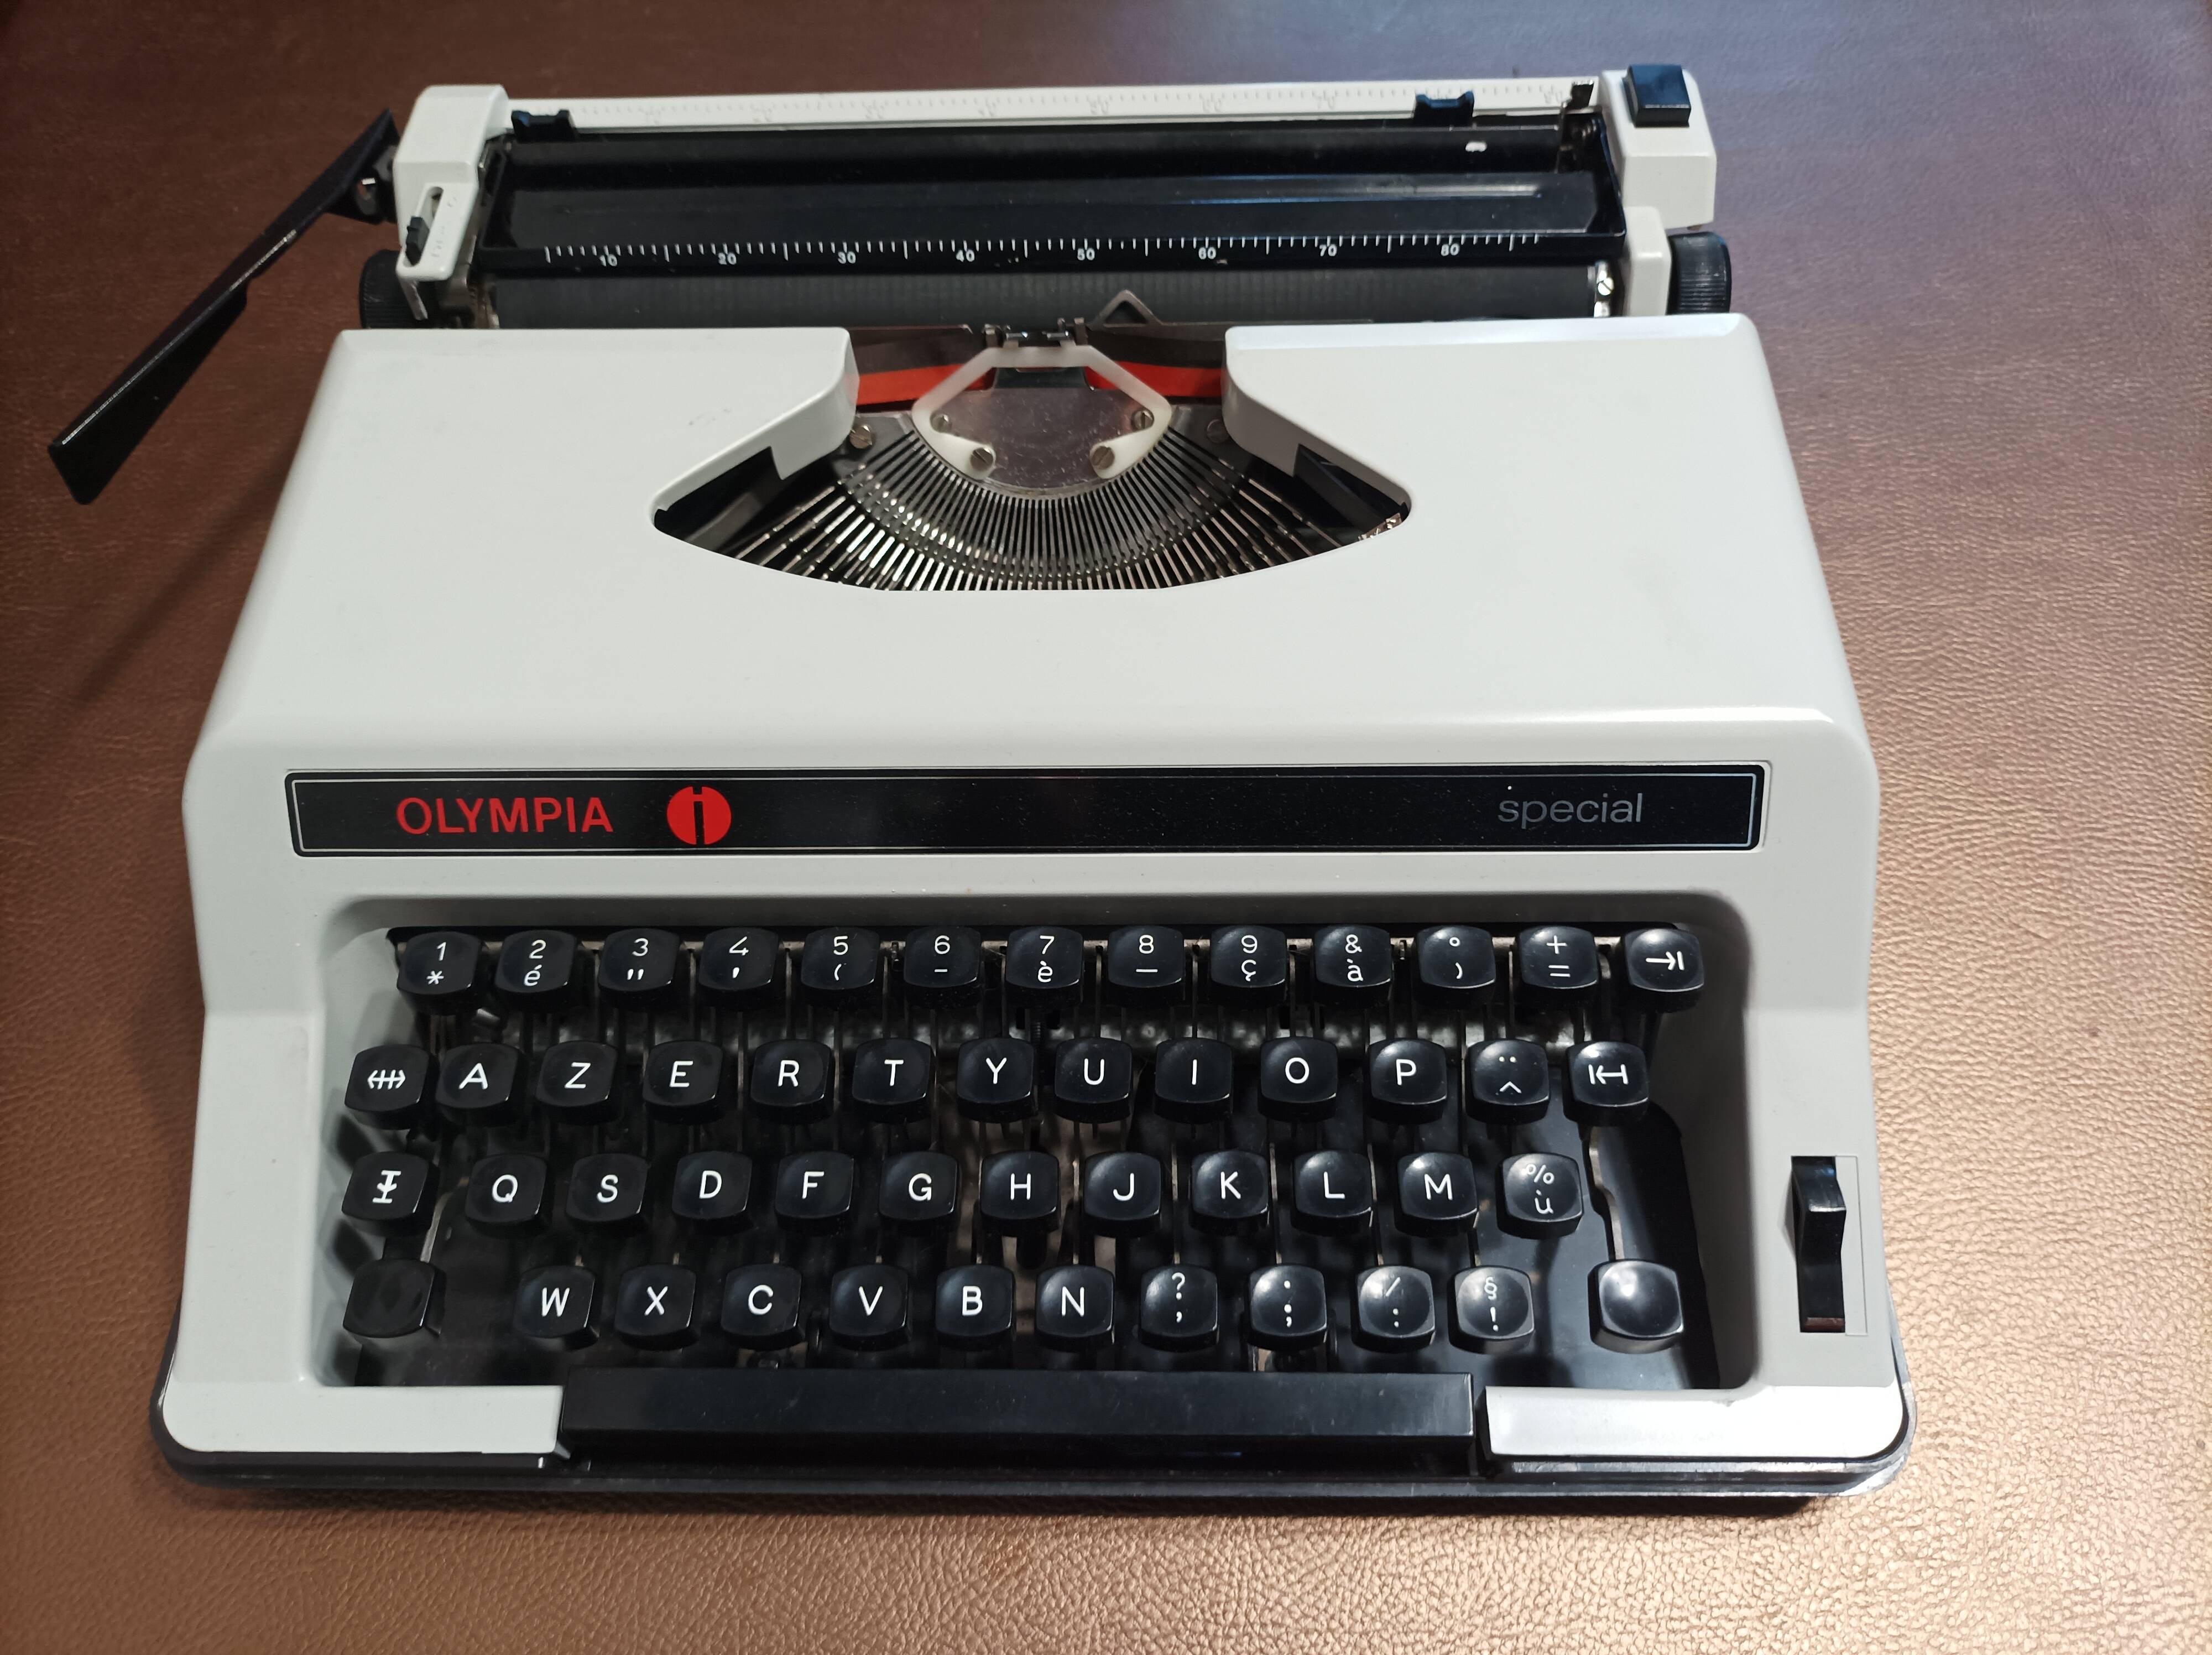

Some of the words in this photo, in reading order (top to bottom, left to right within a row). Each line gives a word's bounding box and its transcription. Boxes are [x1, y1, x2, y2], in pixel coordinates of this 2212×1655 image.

[599, 254, 618, 267] 10
[718, 253, 737, 265] 20
[838, 251, 856, 264] 30
[956, 249, 975, 262] 40
[1077, 248, 1095, 261] 50
[1198, 247, 1217, 259] 60
[1319, 244, 1337, 257] 70
[1441, 243, 1460, 256] 80
[396, 796, 613, 835] OLYMPIA
[1498, 793, 1643, 829] special
[437, 941, 446, 961] 1
[529, 939, 546, 959] 2
[632, 938, 649, 956] 3
[729, 936, 749, 956] 4
[833, 935, 848, 955] 5
[934, 935, 951, 955] 6
[1040, 935, 1055, 955] 7
[1139, 934, 1154, 954] 8
[1241, 935, 1258, 954] 9
[524, 964, 542, 986] é
[1037, 960, 1053, 983] è
[1241, 959, 1256, 982] ç
[1347, 958, 1364, 982] à
[458, 1063, 488, 1090] A
[564, 1061, 591, 1089] Z
[669, 1060, 693, 1087] E
[778, 1060, 800, 1087] R
[884, 1059, 904, 1086] T
[985, 1057, 1007, 1084] Y
[1084, 1058, 1105, 1085] U
[1192, 1059, 1197, 1085] I
[1285, 1057, 1310, 1084] O
[1396, 1058, 1417, 1086] P
[492, 1174, 518, 1203] Q
[597, 1174, 618, 1203] S
[699, 1170, 722, 1199] D
[802, 1171, 825, 1199] F
[909, 1173, 932, 1201] G
[1010, 1173, 1031, 1200] H
[1113, 1173, 1135, 1201] J
[1220, 1171, 1241, 1199] K
[1323, 1171, 1345, 1199] L
[1424, 1173, 1453, 1200] M
[1534, 1189, 1554, 1214] ù
[645, 1286, 668, 1315] X
[748, 1284, 774, 1315] C
[858, 1286, 883, 1316] V
[962, 1286, 983, 1316] B
[1061, 1286, 1084, 1316] N
[1484, 1276, 1498, 1300] §
[541, 1287, 570, 1317] W
